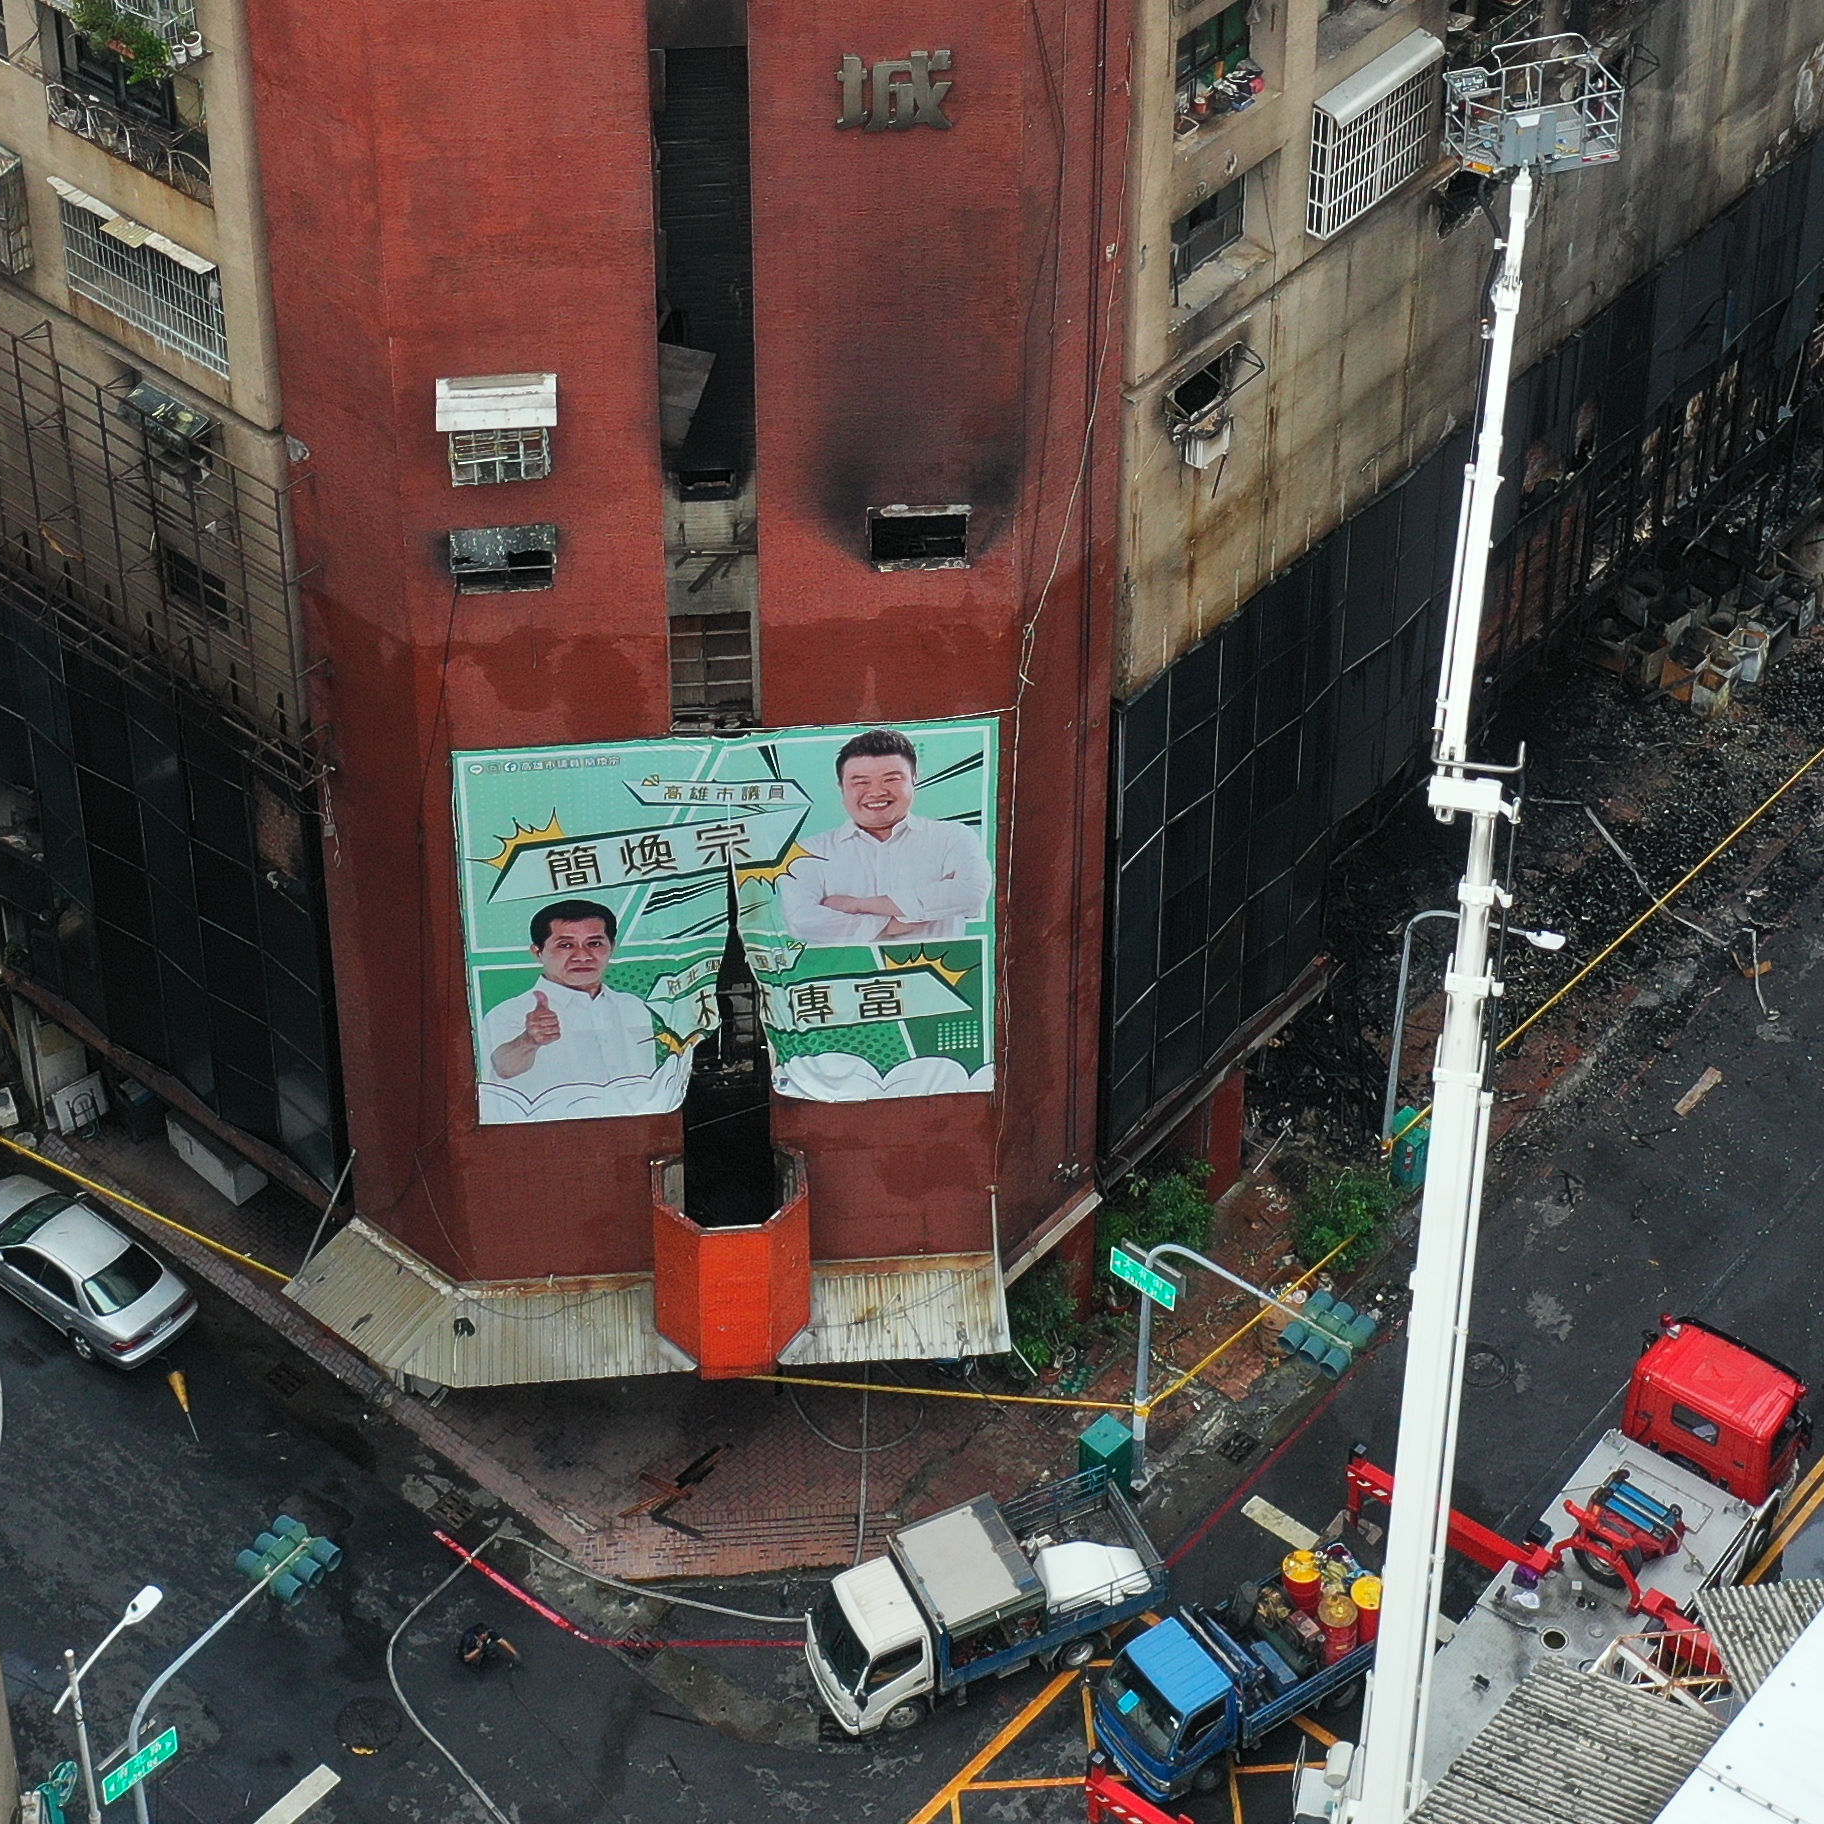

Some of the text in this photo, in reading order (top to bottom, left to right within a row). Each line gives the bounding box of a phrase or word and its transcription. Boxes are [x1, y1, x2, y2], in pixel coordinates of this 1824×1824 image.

[664, 774, 785, 802] 高雄市議員
[546, 824, 753, 891] 簡煥宗
